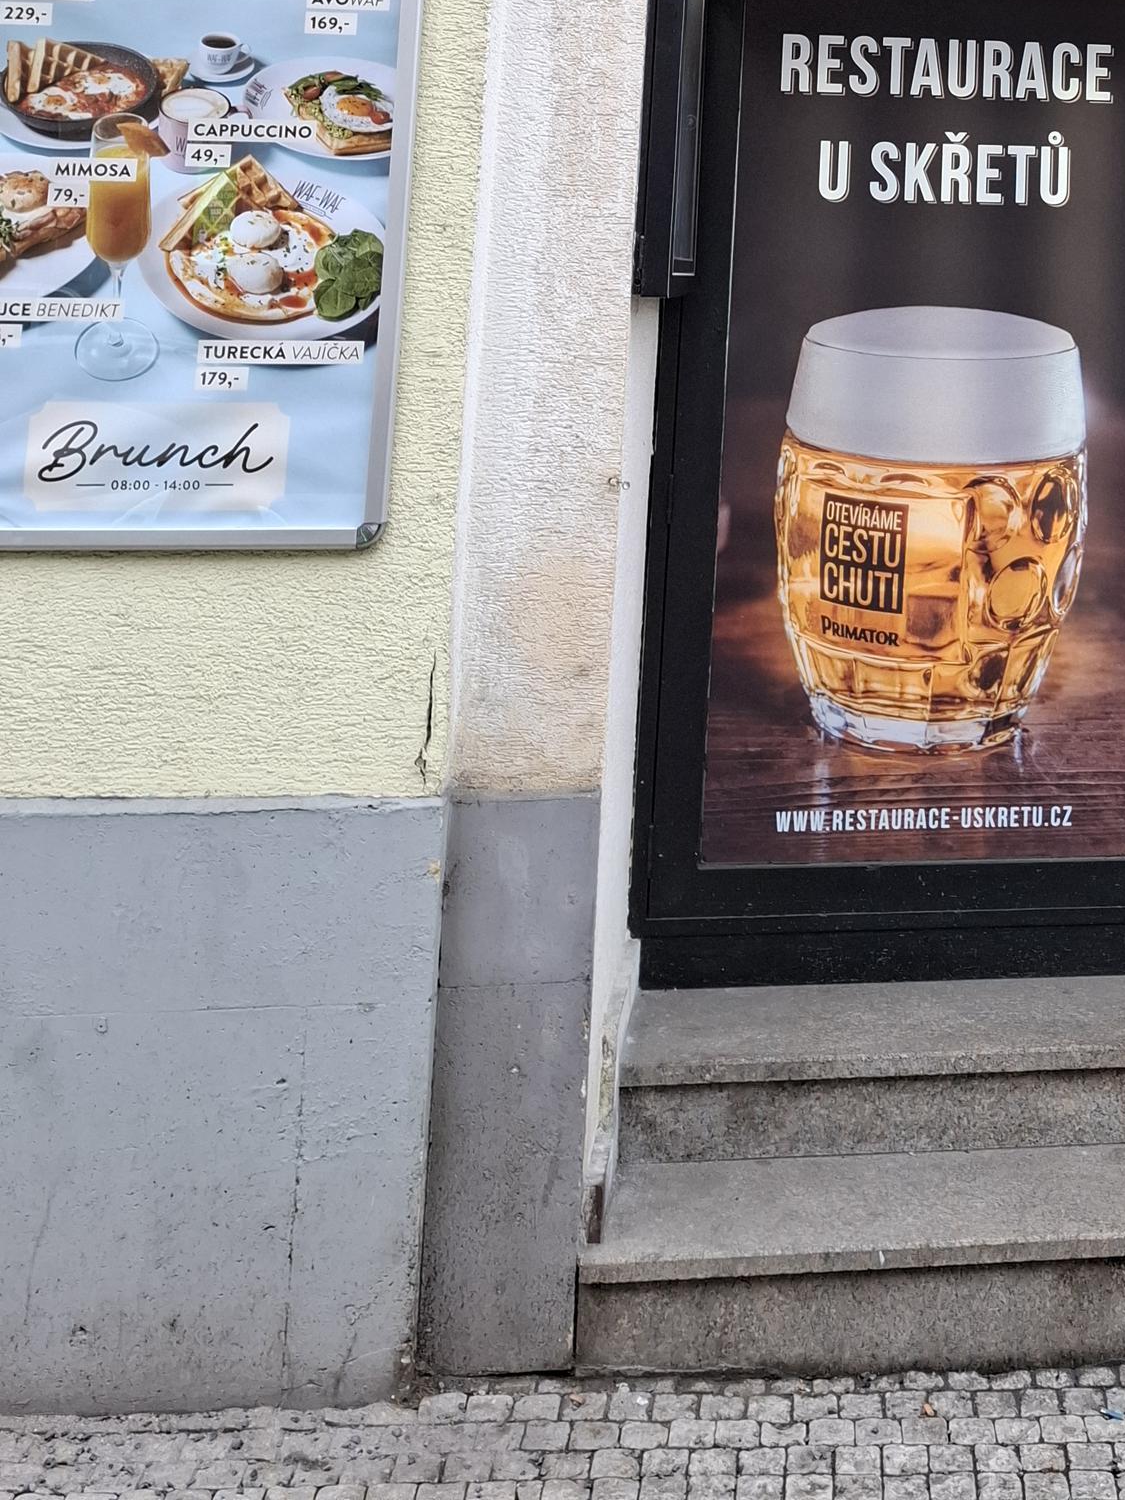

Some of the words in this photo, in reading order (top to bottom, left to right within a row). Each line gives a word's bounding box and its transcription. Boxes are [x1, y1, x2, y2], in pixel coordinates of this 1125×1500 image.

[3, 6, 48, 24] 229,-
[310, 16, 351, 34] 169,-
[780, 33, 1114, 103] RESTAURACE
[193, 123, 312, 139] CAPPUCCINO
[191, 148, 225, 165] 49,-
[55, 162, 132, 178] MIMOSA
[818, 140, 851, 202] U
[869, 131, 1071, 207] SKŘETŮ
[53, 187, 86, 205] 79,-
[36, 303, 120, 318] BENEDIKT
[203, 341, 286, 360] TURECKÁ
[291, 341, 360, 361] VAJÍČKA
[199, 371, 239, 389] 179,-
[37, 420, 275, 483] Brunch
[110, 479, 151, 491] 08:00
[163, 479, 201, 491] 14:00
[826, 501, 903, 531] OTEVÍRÁME
[824, 523, 902, 568] CESTU
[823, 562, 900, 610] CHUTI
[775, 805, 1073, 833] WWW.RESTAURACE-USKRETU.CZ
